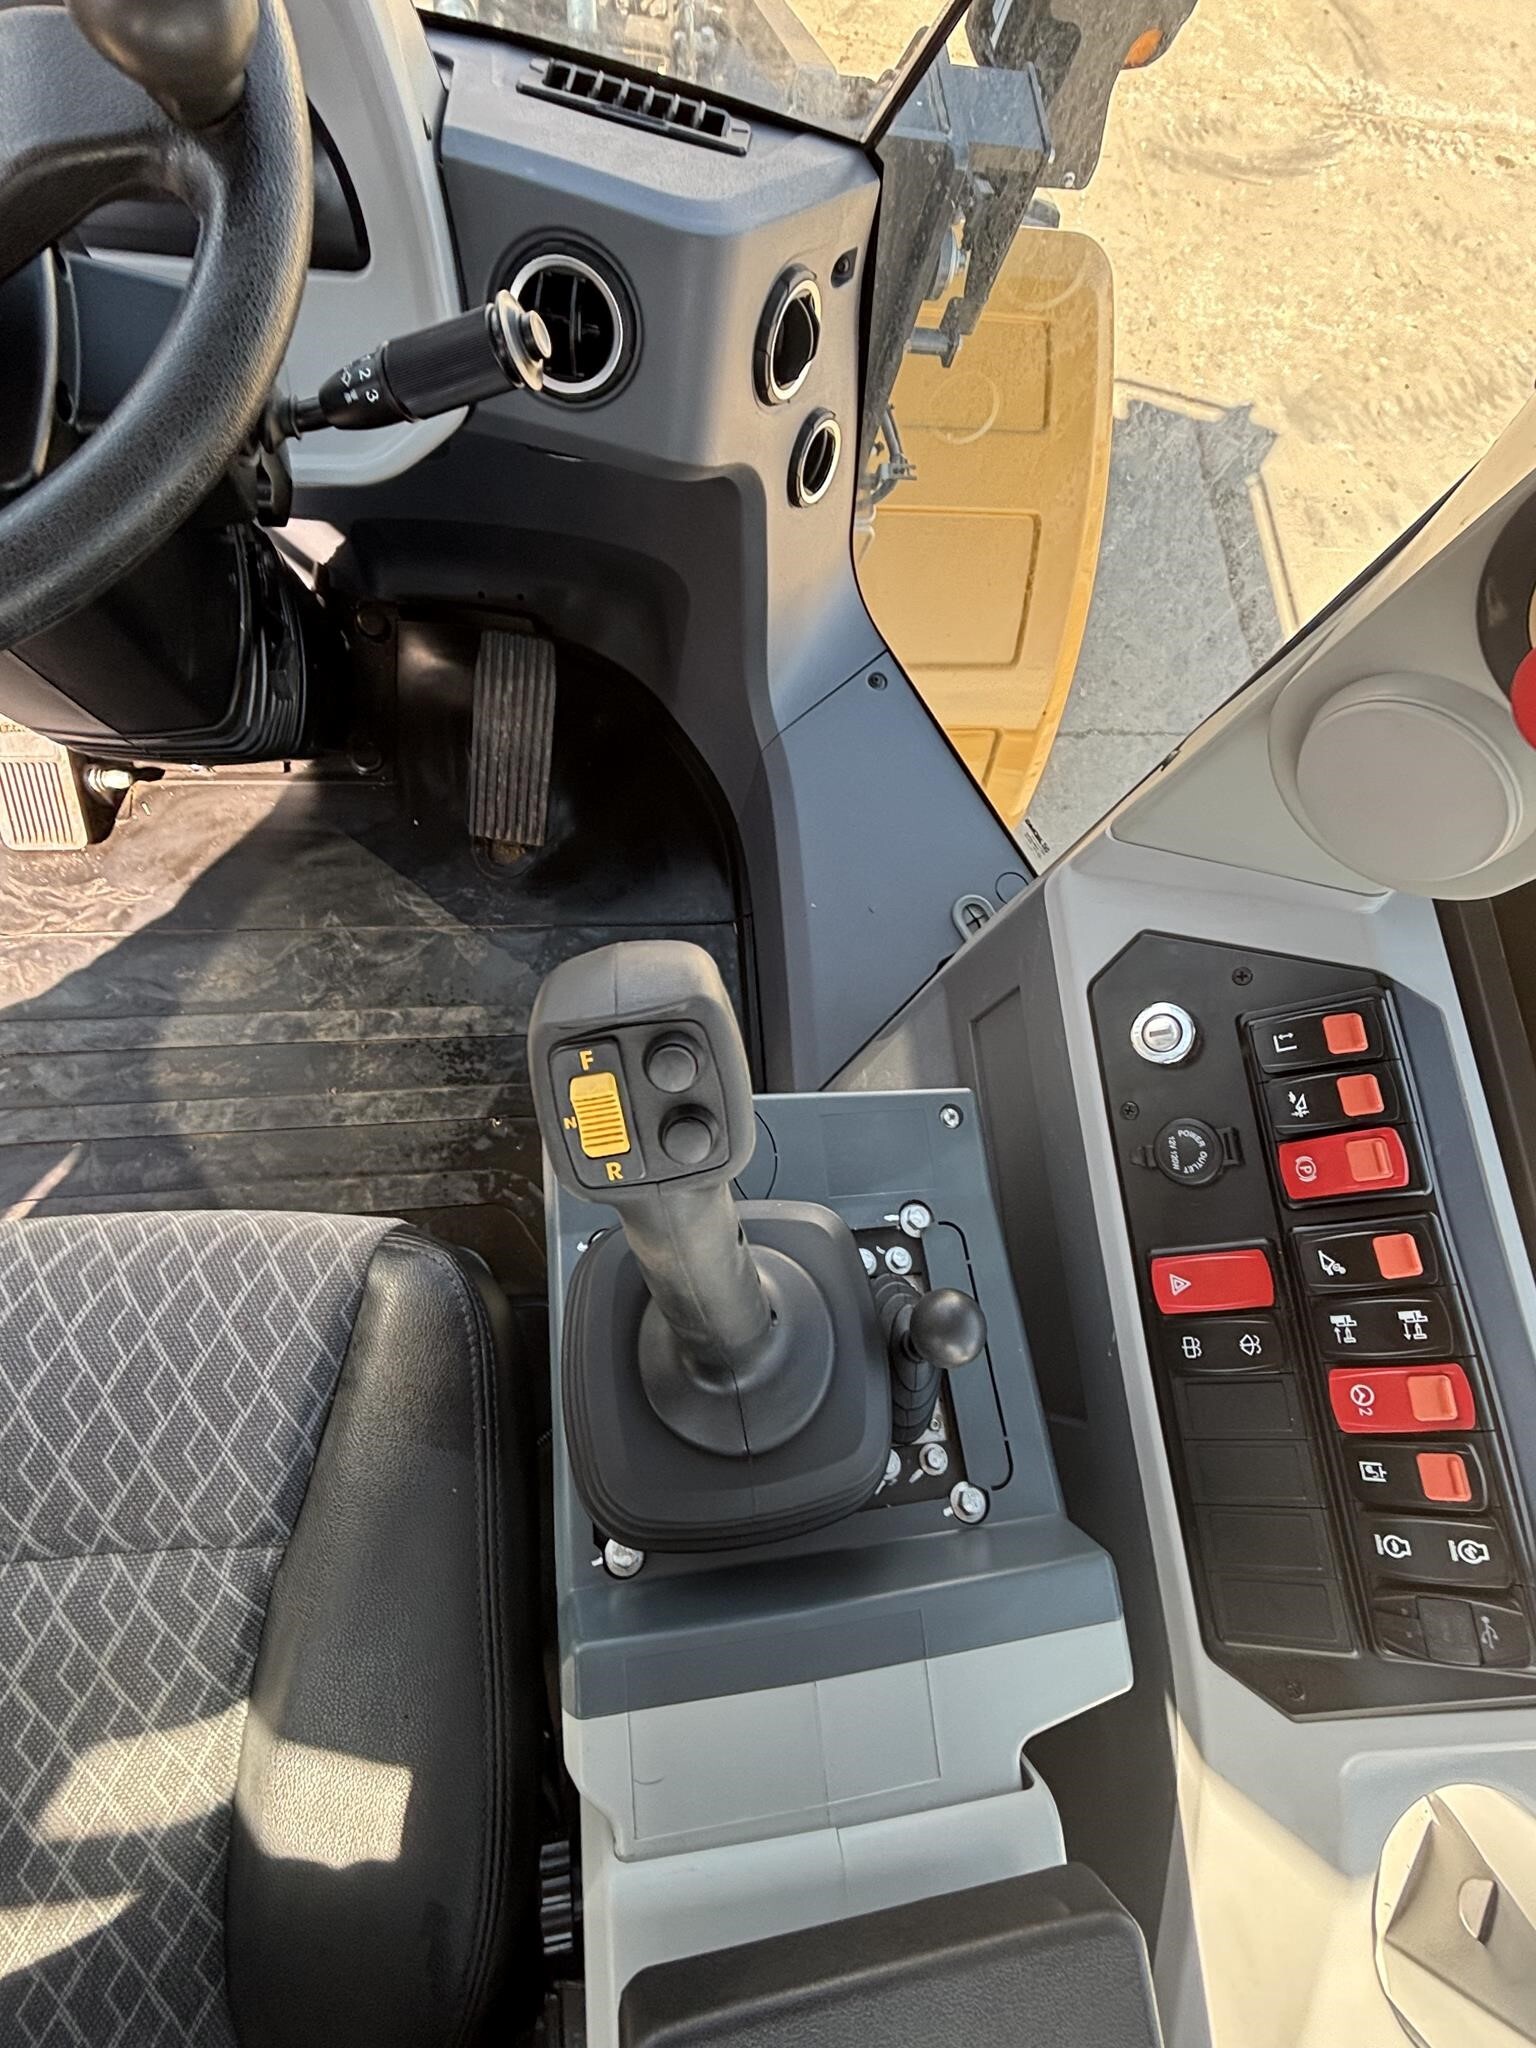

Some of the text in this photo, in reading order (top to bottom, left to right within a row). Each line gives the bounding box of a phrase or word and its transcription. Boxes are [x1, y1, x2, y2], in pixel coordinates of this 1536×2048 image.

[359, 367, 372, 382] 2
[365, 388, 379, 403] 3
[578, 1050, 595, 1072] F
[563, 1116, 579, 1130] N
[1177, 1129, 1208, 1174] POWER OUTLET
[604, 1160, 624, 1181] R
[1359, 1407, 1374, 1417] 2
